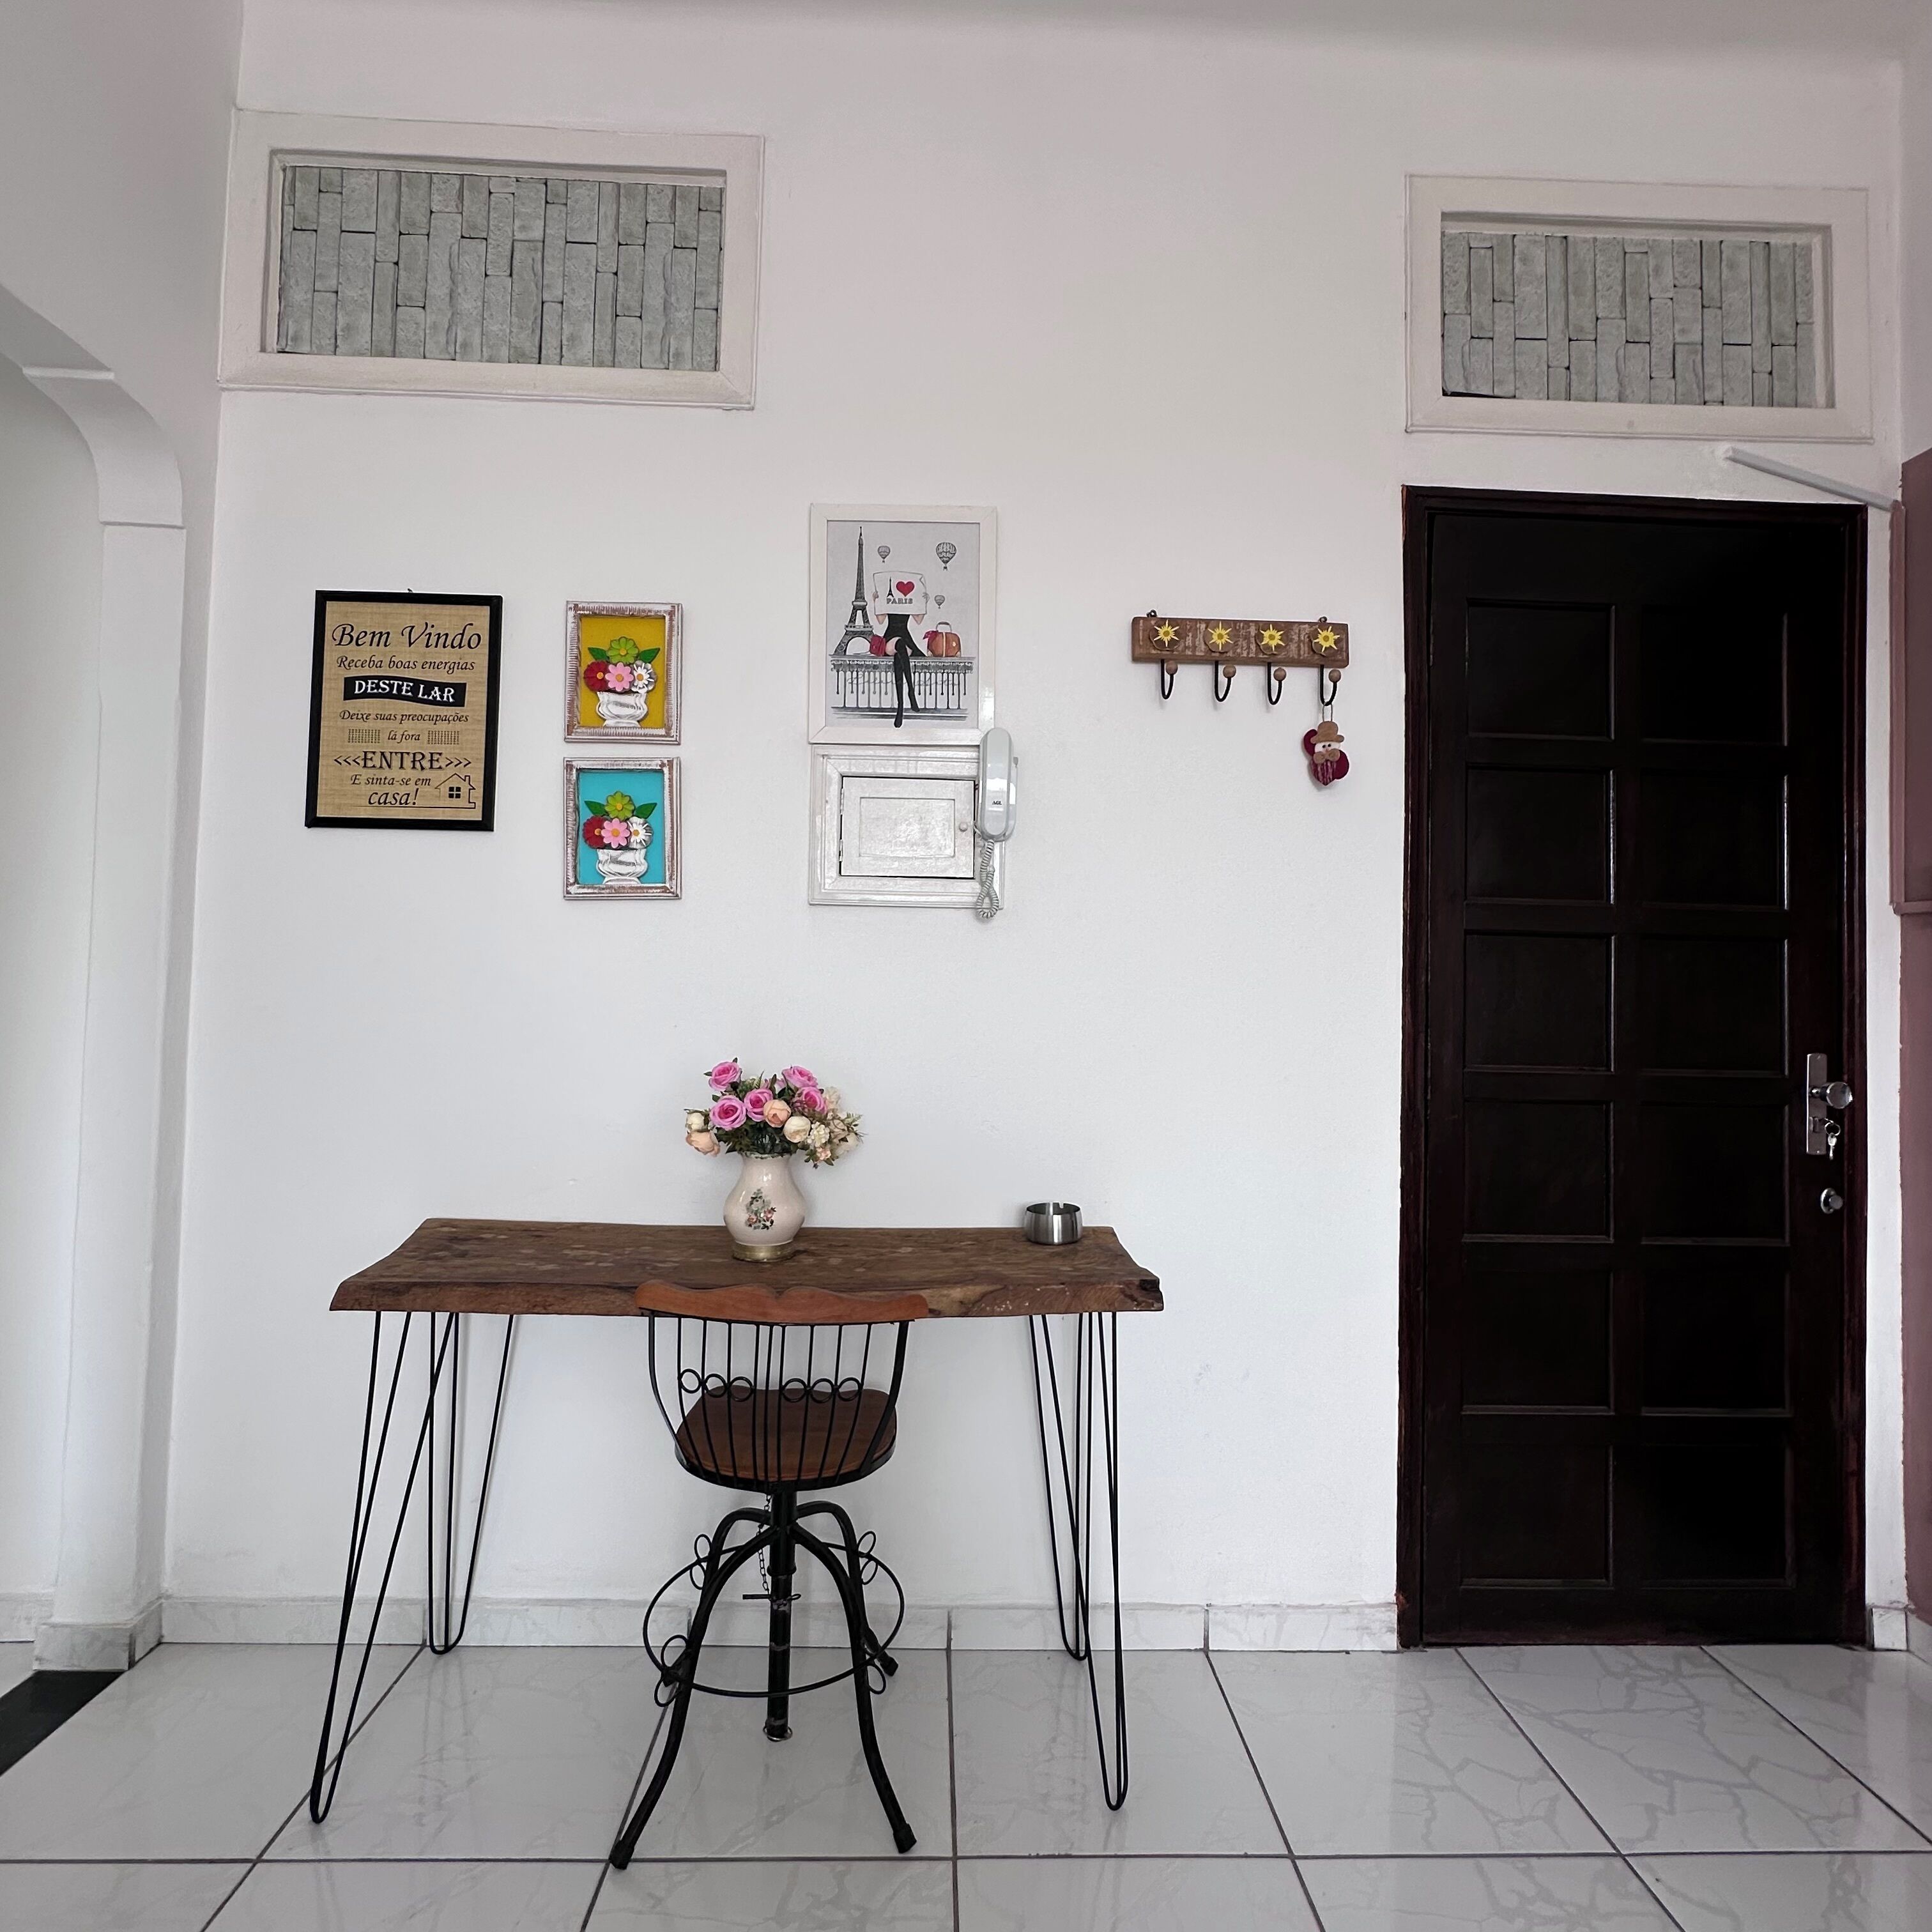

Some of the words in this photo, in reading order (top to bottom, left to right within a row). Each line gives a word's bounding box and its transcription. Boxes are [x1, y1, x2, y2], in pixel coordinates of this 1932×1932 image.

[332, 624, 391, 648] Bem
[401, 622, 482, 650] Vindo
[336, 654, 383, 670] Receba
[388, 655, 418, 670] boas
[421, 660, 475, 674] energias
[354, 679, 413, 697] DESTE
[417, 684, 455, 703] LAR
[339, 710, 371, 722] Deixe
[373, 712, 397, 721] suas
[399, 712, 470, 725] preocupações
[387, 730, 397, 741] lá
[397, 730, 420, 744] fora
[351, 774, 362, 785] E
[364, 774, 411, 786] sinta-se
[415, 778, 431, 786] em
[368, 788, 419, 806] casa!
